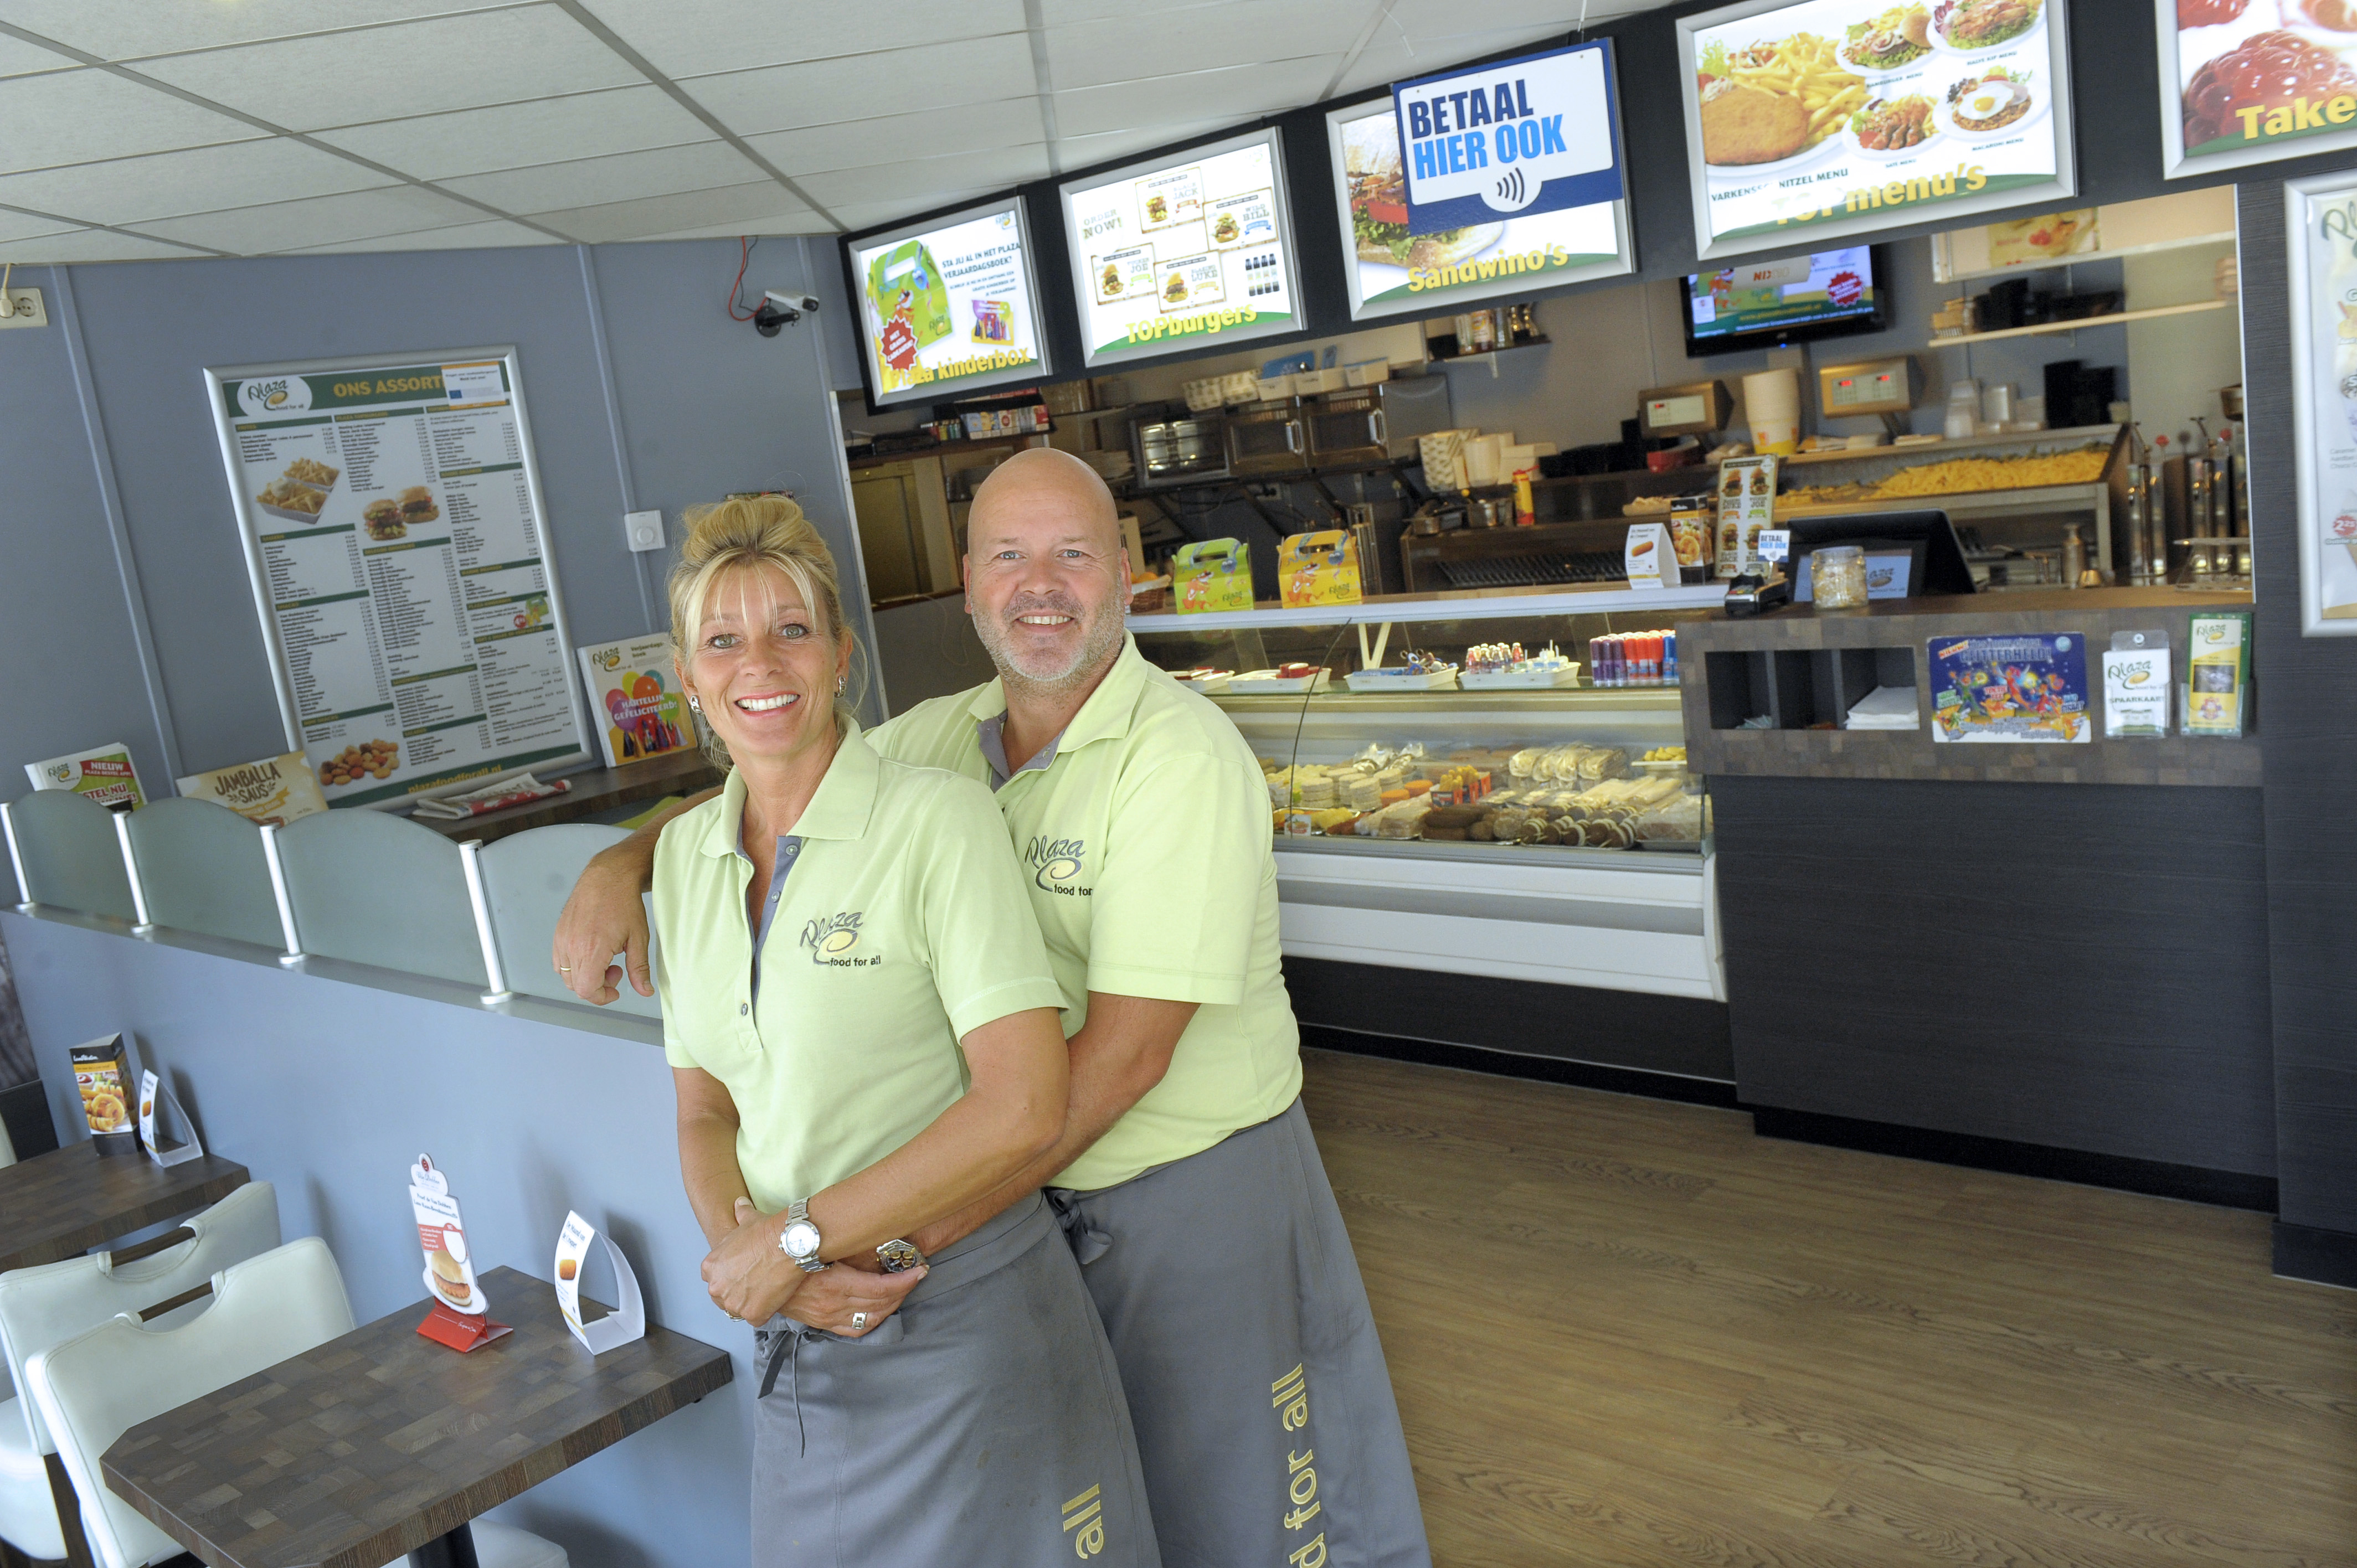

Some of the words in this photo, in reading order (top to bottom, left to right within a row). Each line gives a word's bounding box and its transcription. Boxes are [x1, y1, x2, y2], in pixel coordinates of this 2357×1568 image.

[1999, 50, 2018, 59] MENU
[1408, 79, 1533, 140] BETAAL
[2235, 94, 2357, 140] Take
[1413, 131, 1488, 180] HIER
[1495, 114, 1567, 164] OOK
[1816, 168, 1849, 182] MENU
[1173, 188, 1198, 200] JACK
[1083, 209, 1117, 226] ORDER
[1243, 209, 1270, 221] BILL
[1082, 216, 1123, 240] NOW!
[984, 248, 996, 257] HET
[998, 243, 1021, 254] PLAZA
[1130, 263, 1149, 274] JOE
[1191, 270, 1218, 281] LUKE
[1407, 243, 1569, 292] Sandwino's
[1125, 304, 1257, 344] TOPburgers
[890, 366, 935, 389] Plaza
[938, 346, 1032, 380] kinderbox
[333, 382, 371, 398] ONS
[375, 375, 445, 395] ASSORT
[593, 647, 619, 665] Plaza
[2108, 661, 2152, 679] Plaza
[614, 701, 677, 721] GEFELICITEERD!
[621, 694, 665, 709] HARTELIJK
[91, 762, 123, 771] NIEUW
[110, 783, 127, 794] NU
[215, 761, 282, 796] JAMBALLA
[238, 783, 269, 804] SAUS
[1025, 834, 1085, 869] Plaza
[1053, 883, 1075, 896] food
[1078, 886, 1093, 896] for
[800, 911, 864, 949] Plaza
[830, 956, 851, 967] food
[853, 956, 868, 966] for
[870, 955, 881, 966] all
[1272, 1362, 1308, 1432] all
[1283, 1448, 1321, 1531] for
[1062, 1483, 1104, 1560] all
